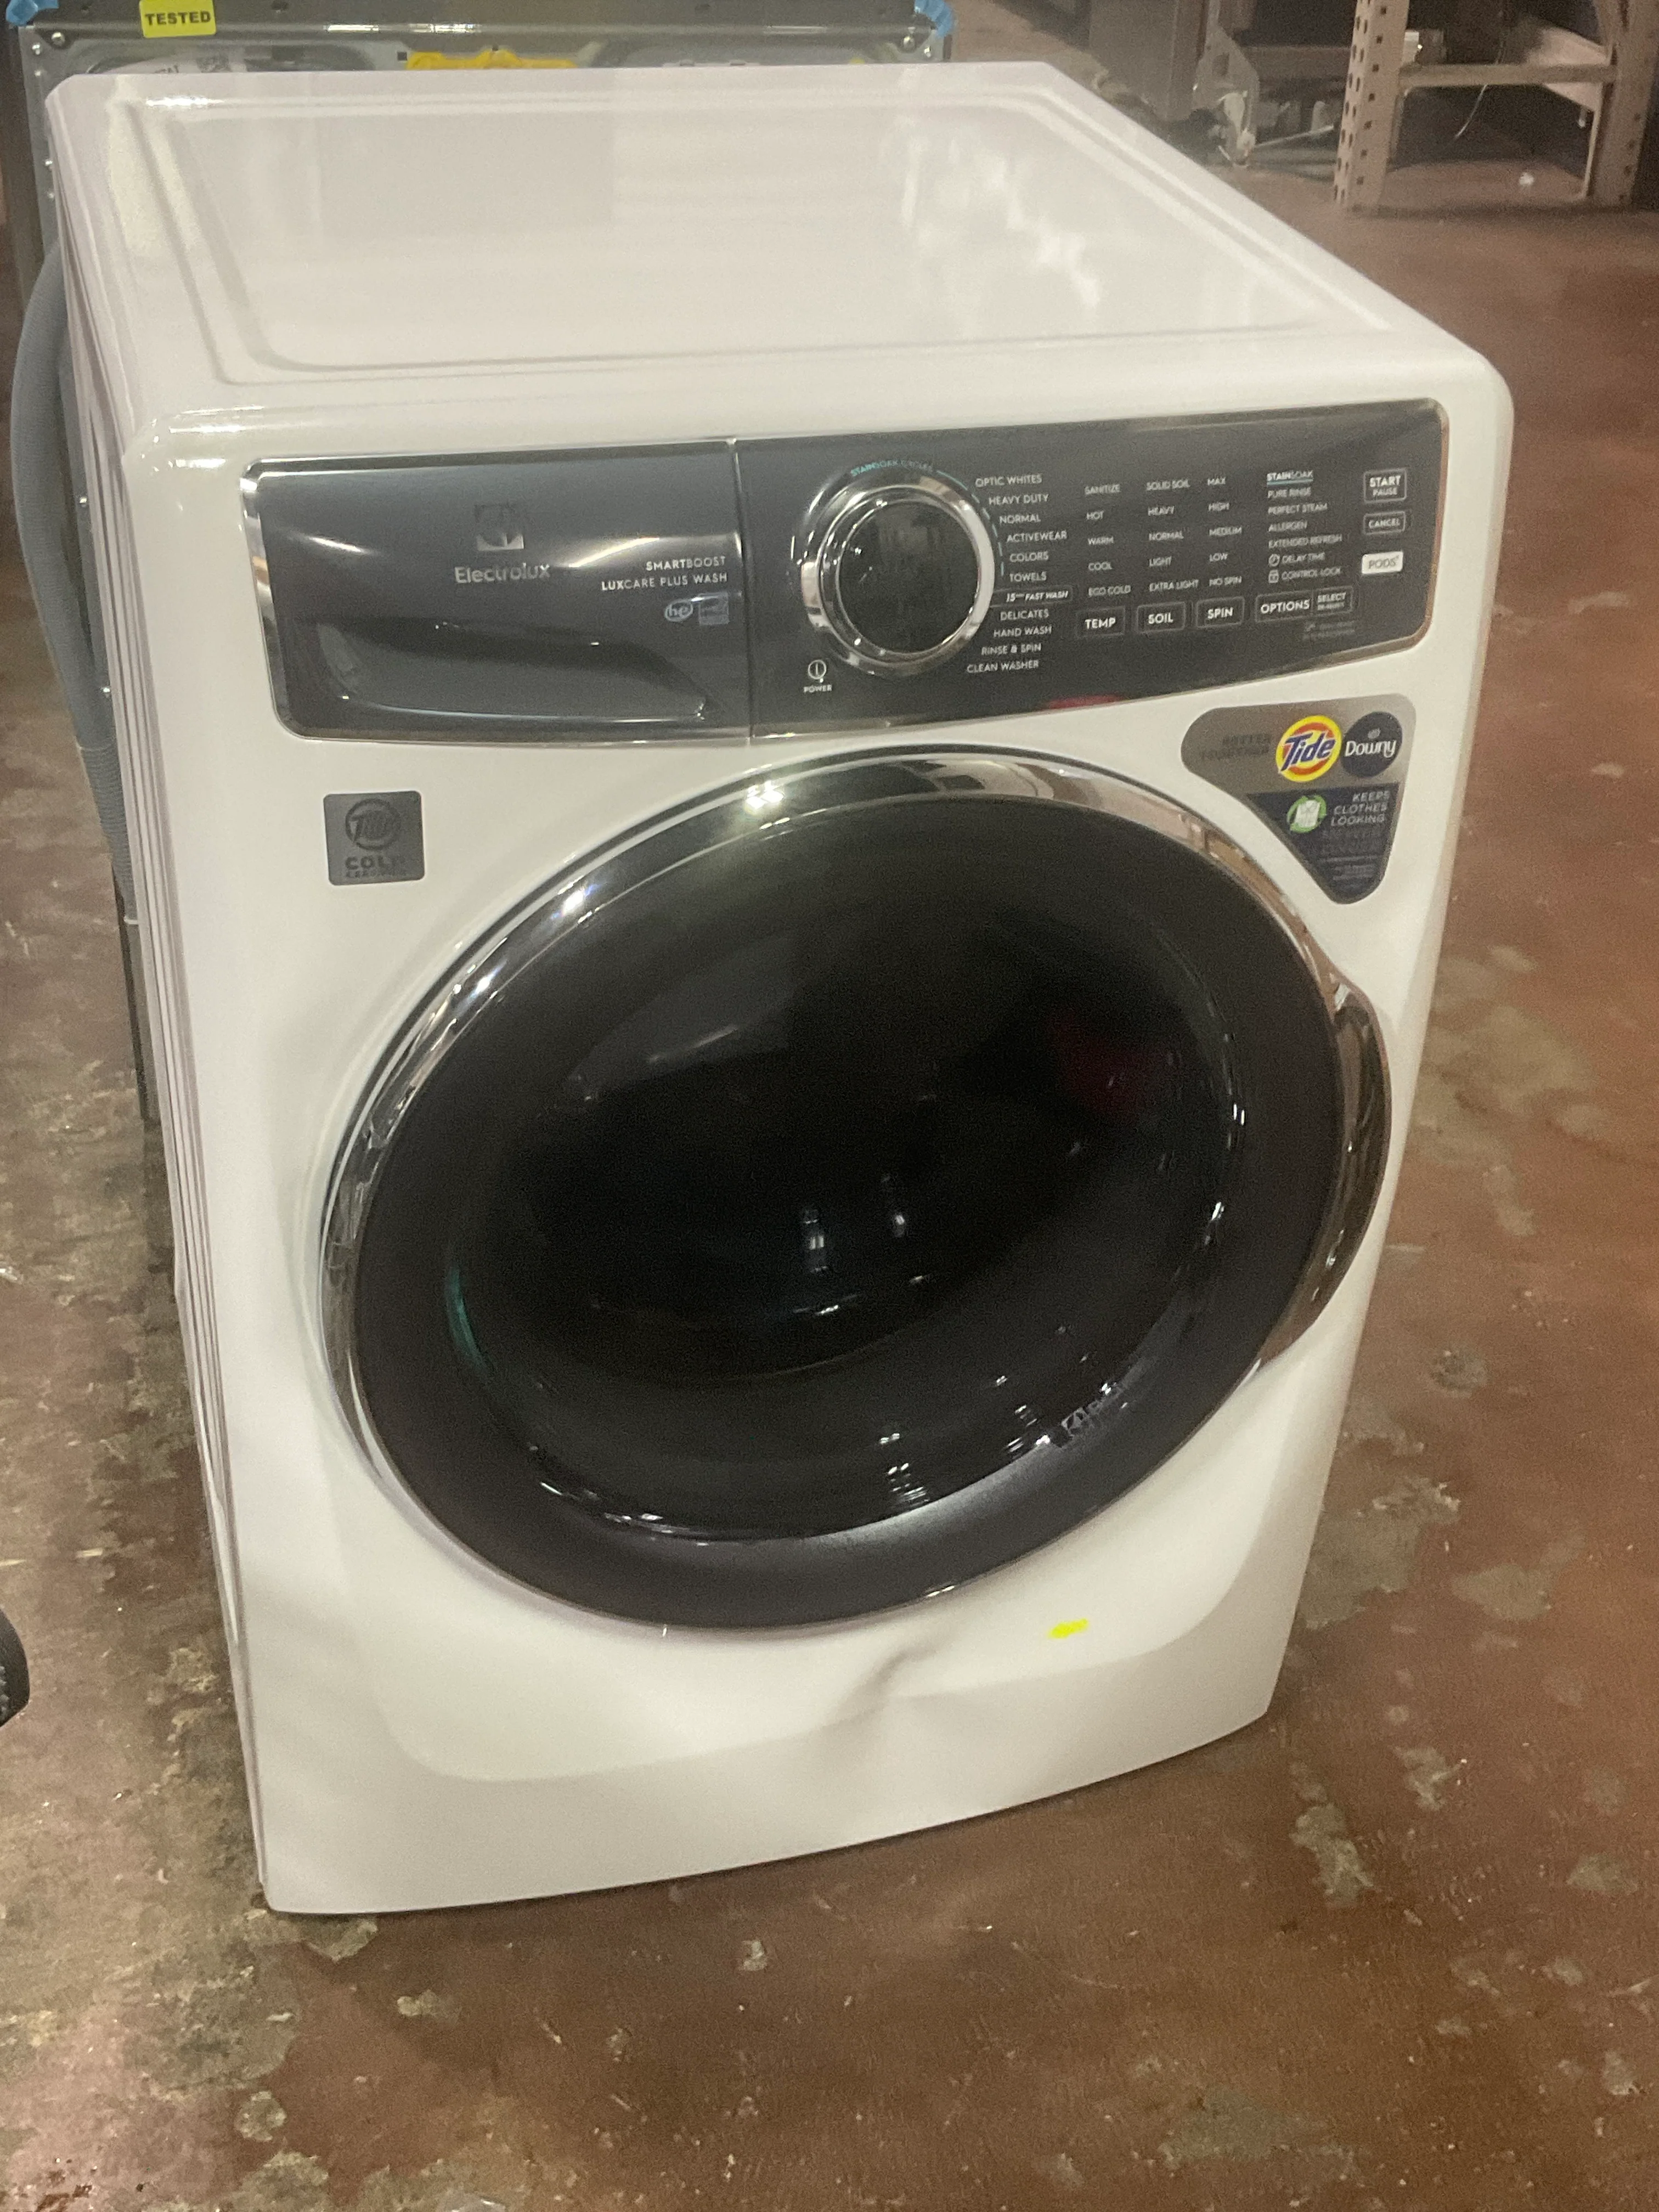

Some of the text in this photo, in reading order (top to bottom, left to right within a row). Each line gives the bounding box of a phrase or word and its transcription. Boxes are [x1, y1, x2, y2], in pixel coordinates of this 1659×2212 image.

[145, 10, 211, 27] TESTED
[975, 474, 1042, 488] OPTIC WHITES
[1207, 477, 1226, 486] MAX
[1370, 476, 1401, 487] START
[1084, 484, 1121, 495] SANITIZE
[1373, 487, 1397, 496] PAUSE
[989, 494, 1049, 505] HEAVY DUTY
[999, 515, 1041, 524] NORMAL
[1086, 510, 1104, 521] HOT
[1369, 518, 1400, 529] CANCEL
[1006, 531, 1067, 543] ACTIVEWEAR
[1087, 536, 1114, 545] WARM
[1149, 531, 1183, 541] NORMAL
[1009, 552, 1049, 562] COLORS
[1149, 556, 1172, 567] LIGHT
[1210, 552, 1228, 562] LOW
[646, 556, 726, 572] SMARTBOOST
[1088, 562, 1113, 571] COOL
[455, 563, 550, 584] Electrolux
[1009, 572, 1047, 583] TOWELS
[602, 572, 727, 591] LUXCARE PLUS WASH
[1209, 576, 1242, 586] NO SPIN
[1025, 592, 1045, 601] FAST
[1046, 590, 1069, 599] WASH
[1088, 587, 1107, 597] ECO
[1317, 592, 1346, 603] SELECT
[1261, 599, 1310, 614] OPTIONS
[1000, 609, 1049, 621] DELICATES
[1148, 612, 1173, 624] SOIL
[1207, 607, 1233, 619] SPIN
[1085, 617, 1116, 629] TEMP
[994, 626, 1052, 637] HAND WASH
[981, 643, 1042, 656] RINSE & SPIN
[967, 660, 1039, 674] CLEAN WASHER
[803, 685, 832, 693] POWER
[1278, 731, 1336, 772] Tide
[1345, 739, 1397, 758] Downy
[1352, 790, 1390, 802] KEEPS
[1334, 802, 1387, 815] CLOTHES
[1331, 814, 1386, 826] LOOKING
